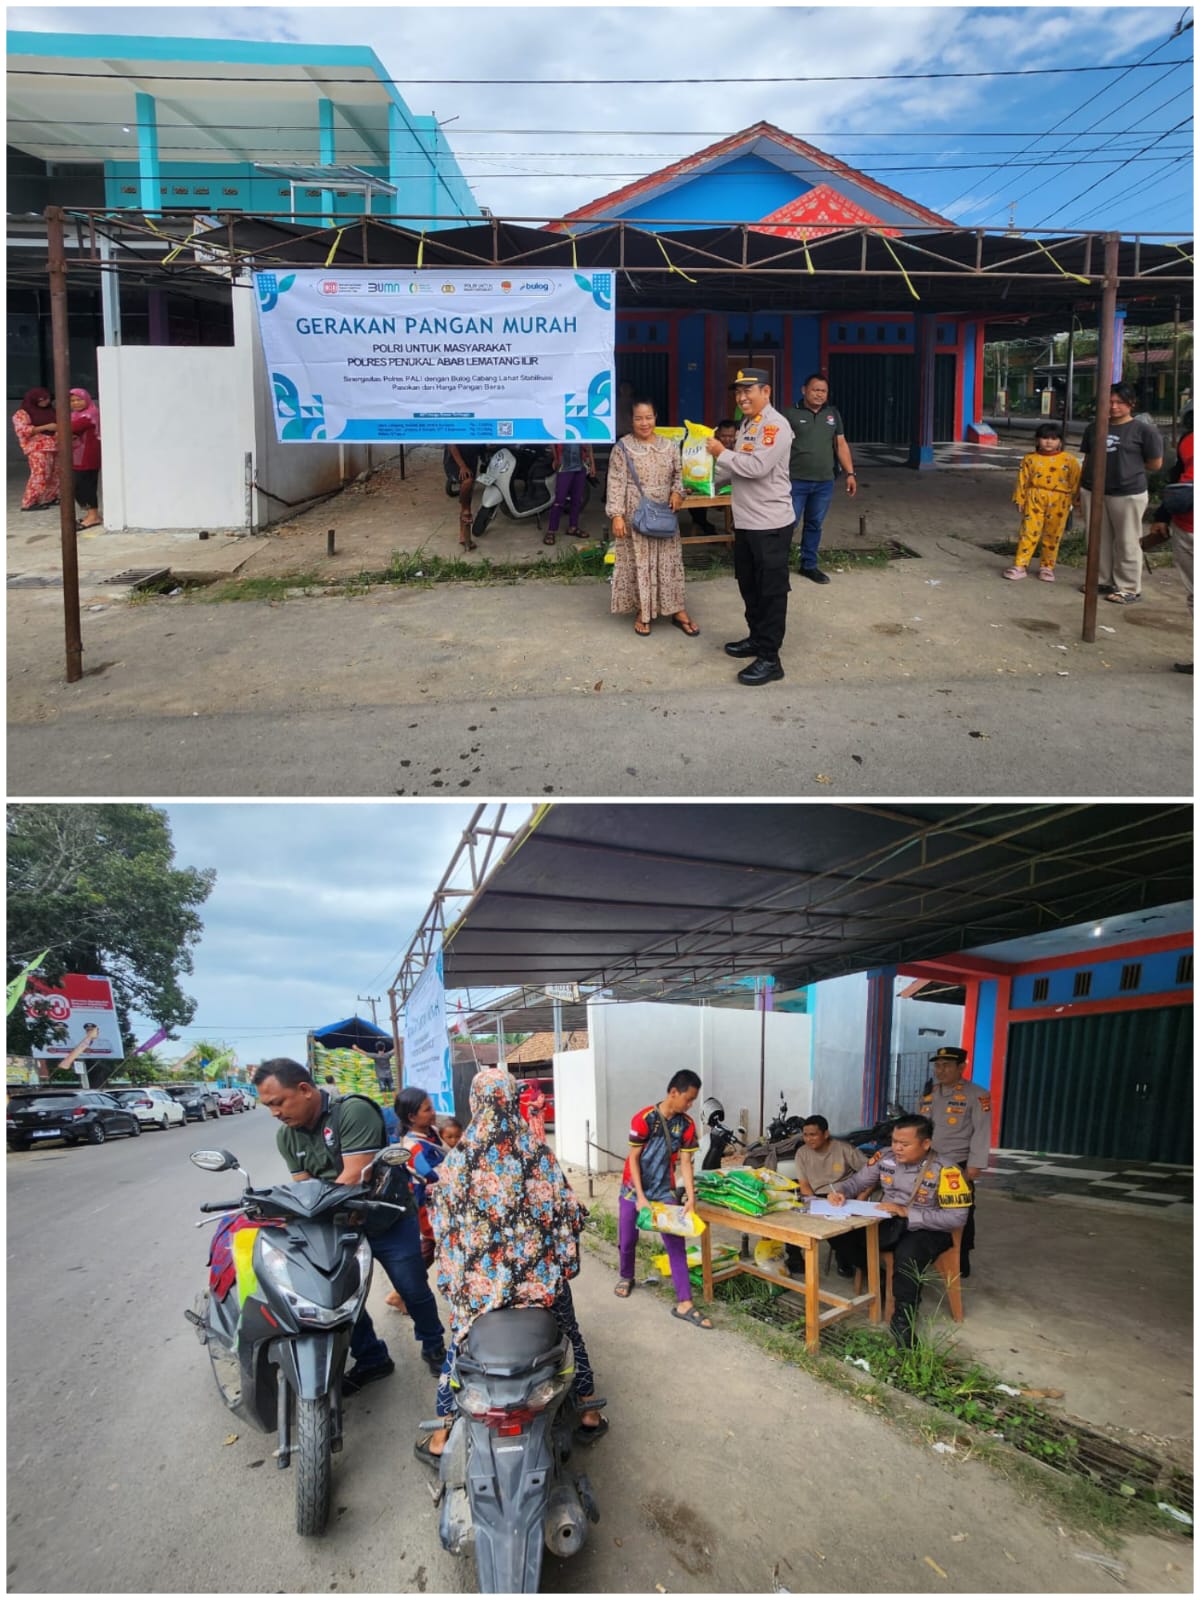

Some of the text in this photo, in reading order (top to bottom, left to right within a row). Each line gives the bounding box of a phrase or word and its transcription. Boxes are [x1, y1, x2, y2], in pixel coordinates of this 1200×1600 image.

[526, 282, 549, 292] bulog
[296, 316, 578, 335] GERAKAN PANGAN MURAH
[373, 343, 513, 353] POLRI UNTUK MASYARAKAT
[347, 356, 539, 367] POLRES PENUKAL ABAB LEMATANG ILIR
[424, 375, 450, 383] dengan
[451, 375, 471, 383] Bulog
[471, 375, 498, 383] Cabang
[436, 384, 457, 392] Harga
[458, 384, 482, 392] Pangan
